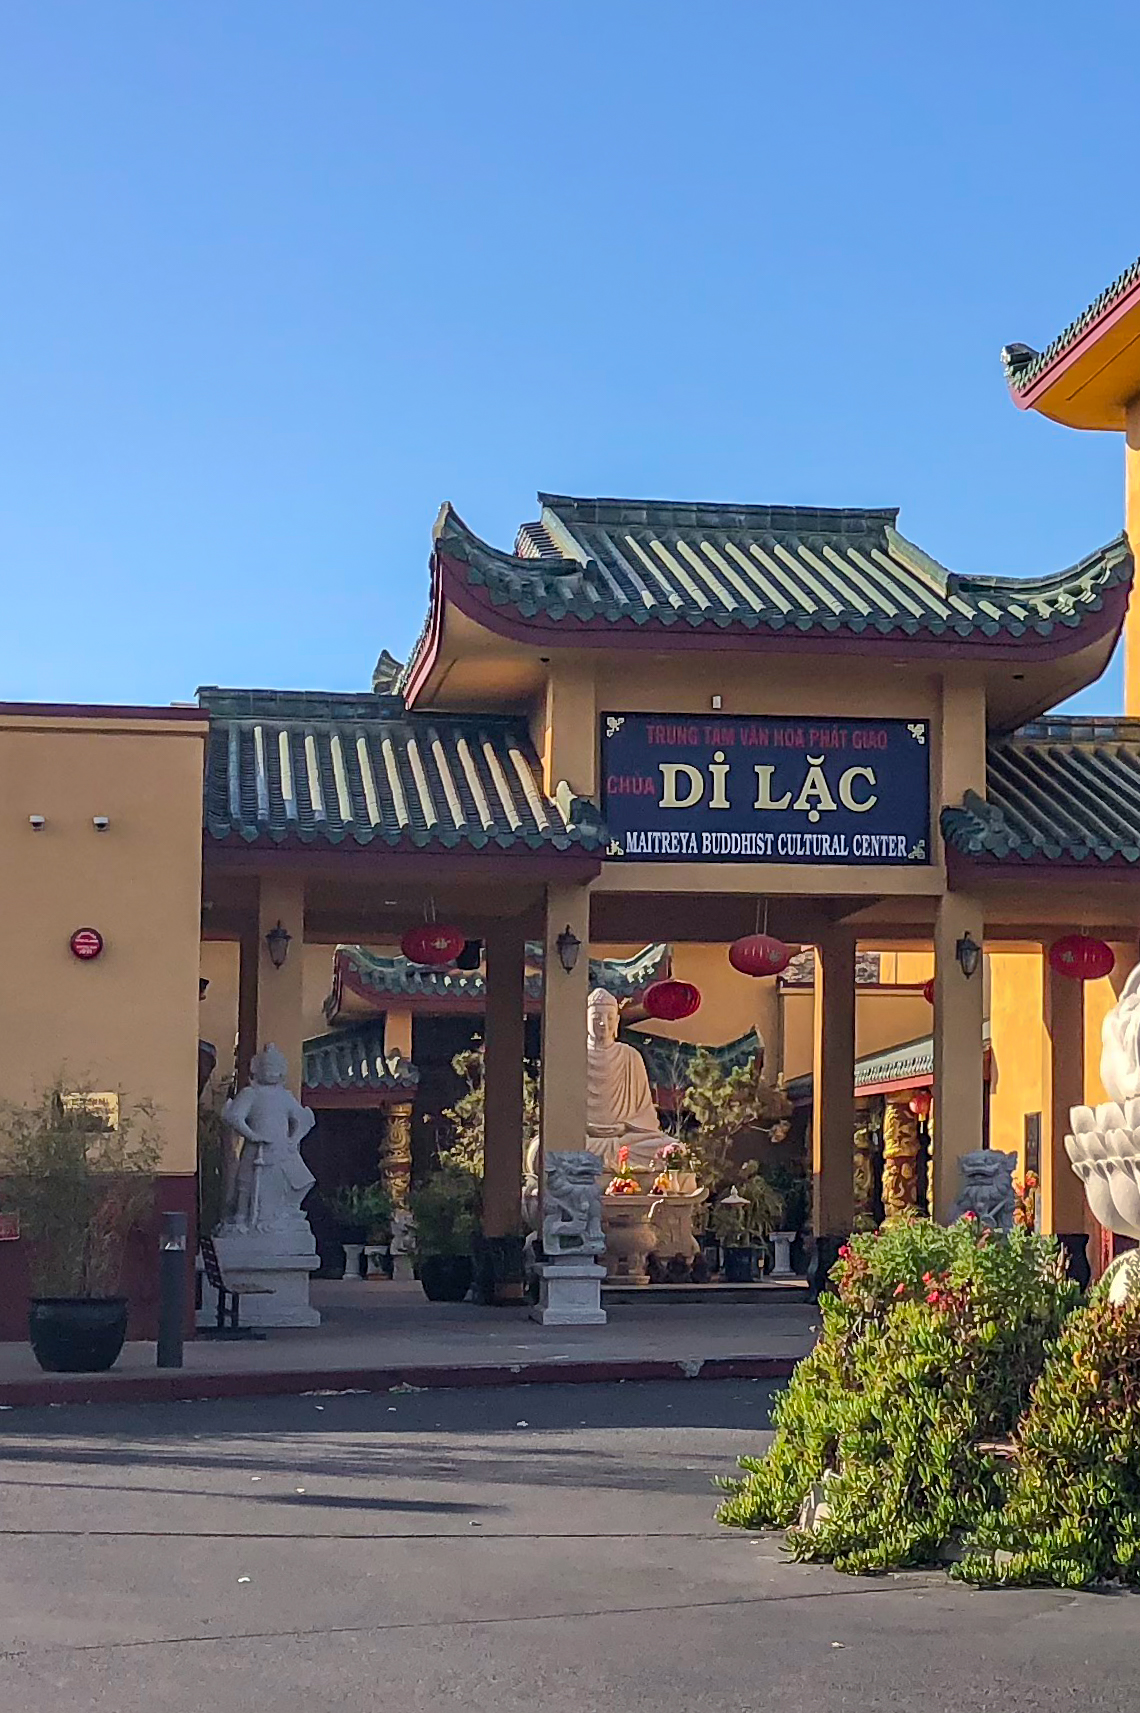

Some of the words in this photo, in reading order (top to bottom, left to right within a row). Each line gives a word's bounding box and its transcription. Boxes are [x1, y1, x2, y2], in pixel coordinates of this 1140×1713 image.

[646, 725, 699, 746] TRUNG
[753, 754, 878, 823] LẶC
[625, 831, 699, 855] MAITREYA
[701, 832, 775, 856] BUDDHIST
[777, 833, 850, 857] CULTURAL
[852, 834, 908, 858] CENTER
